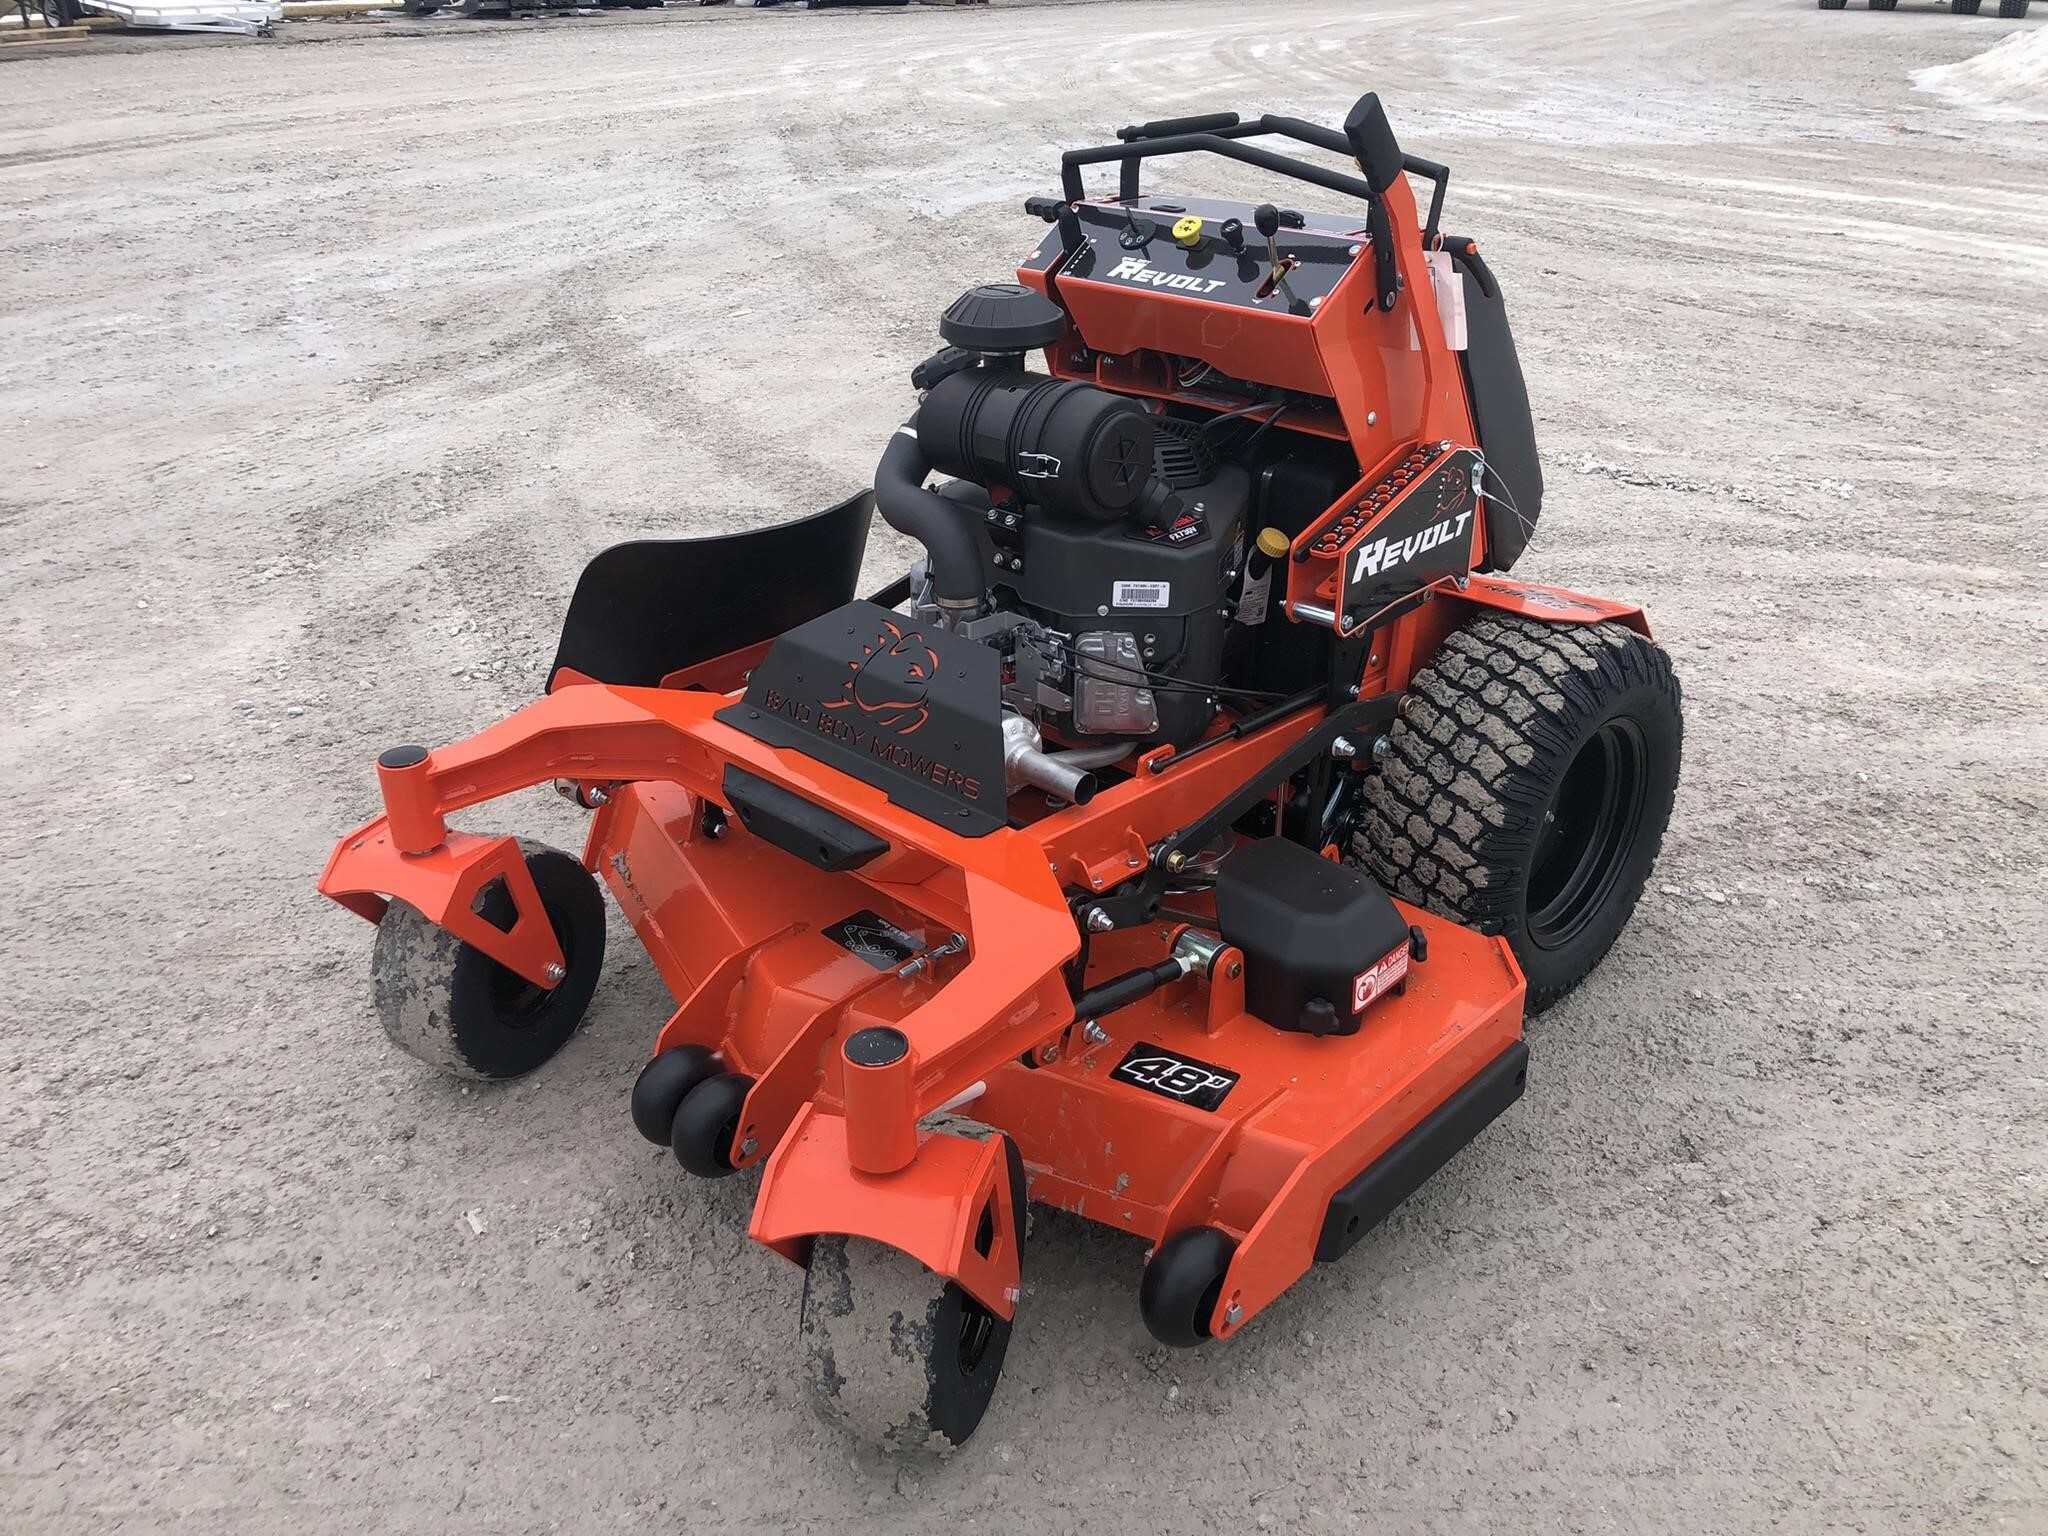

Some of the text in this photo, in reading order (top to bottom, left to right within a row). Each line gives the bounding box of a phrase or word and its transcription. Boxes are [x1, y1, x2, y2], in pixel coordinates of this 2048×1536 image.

[1106, 260, 1226, 293] REVOLT
[1351, 510, 1472, 584] REVOLT
[765, 689, 982, 801] BAD BOY MOWERS
